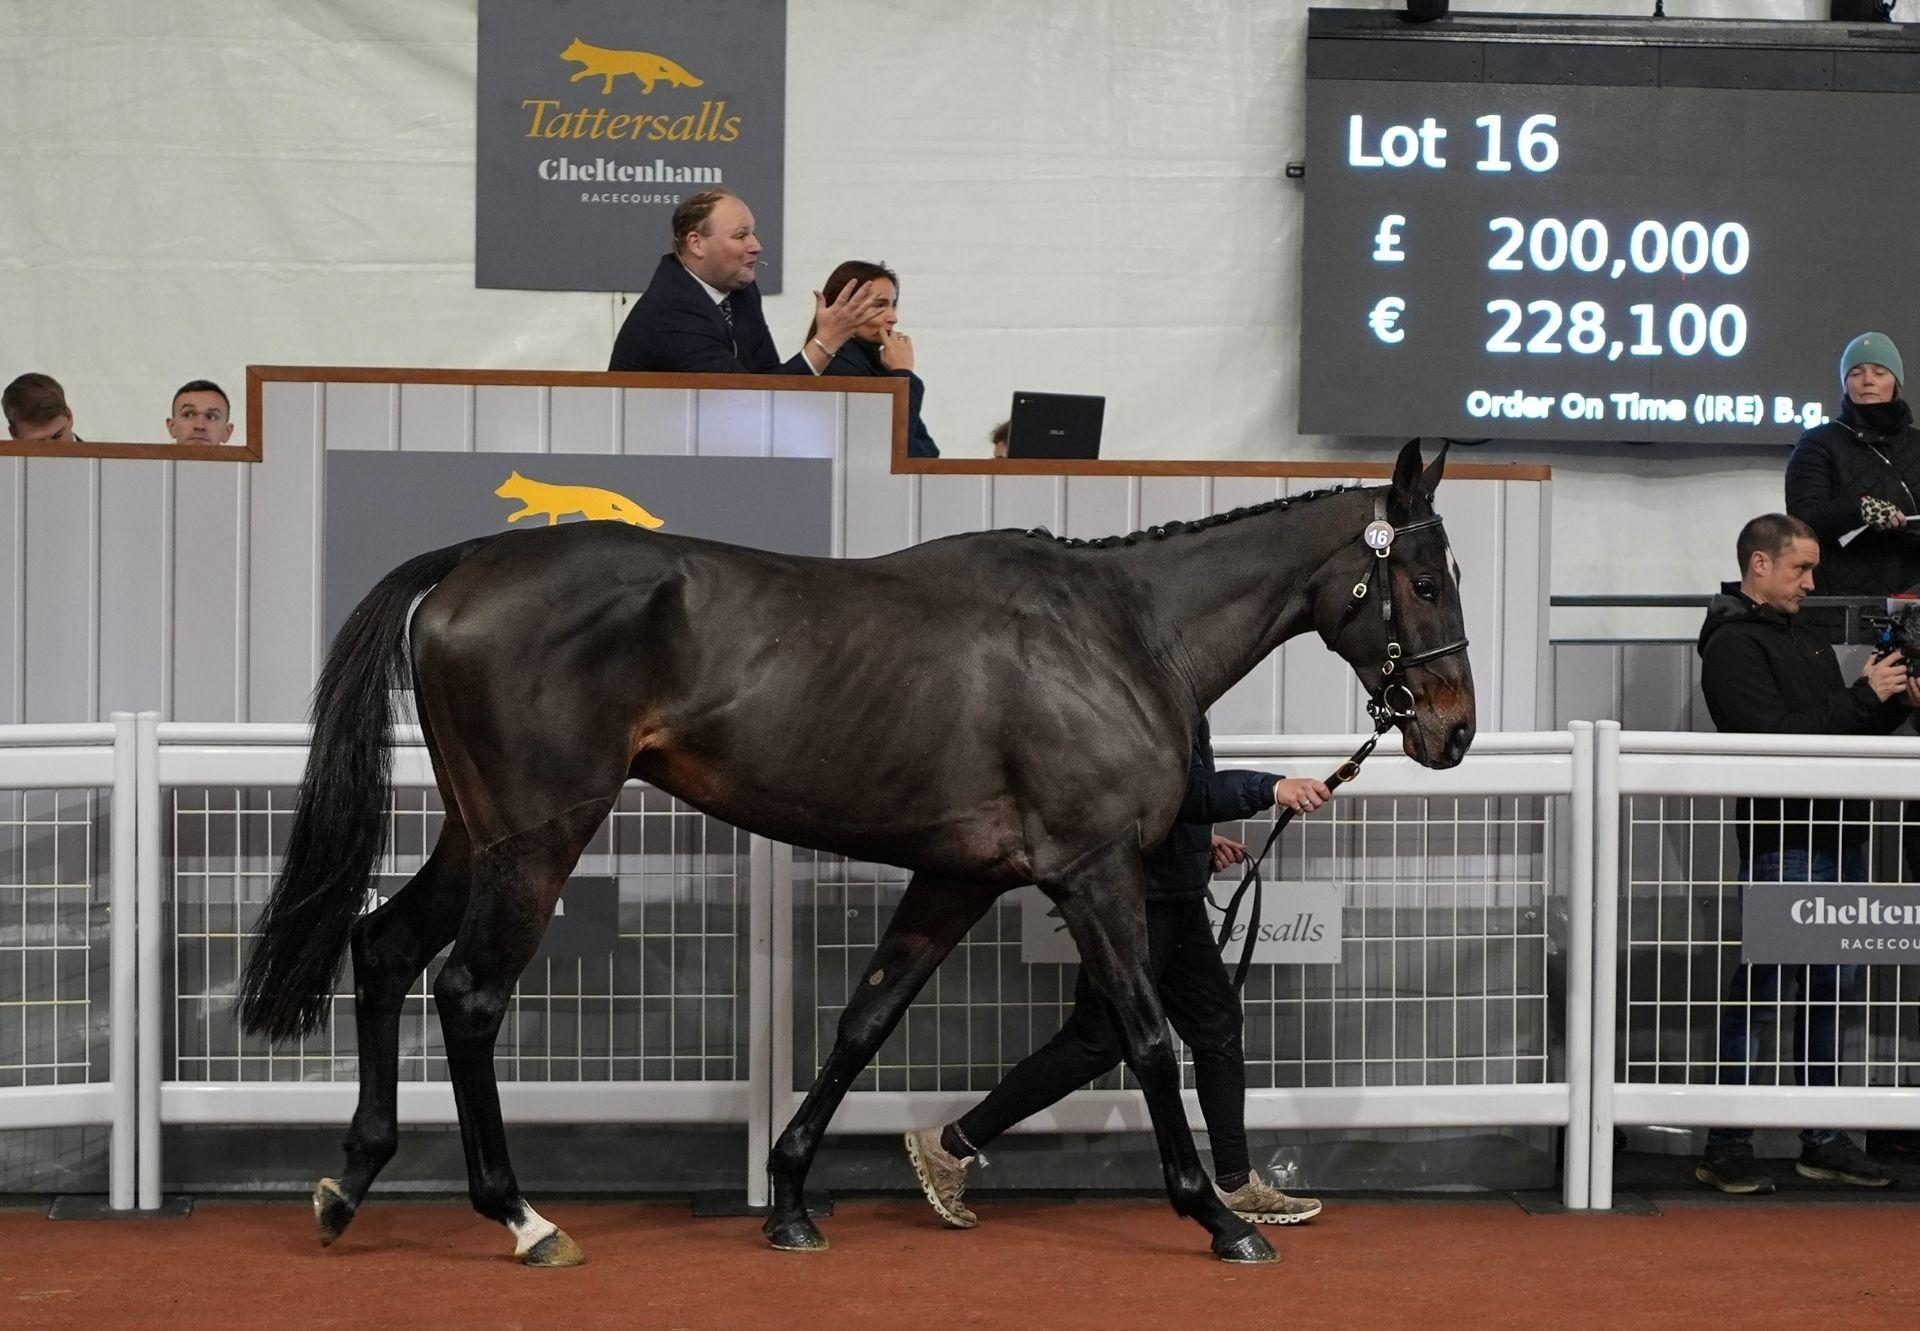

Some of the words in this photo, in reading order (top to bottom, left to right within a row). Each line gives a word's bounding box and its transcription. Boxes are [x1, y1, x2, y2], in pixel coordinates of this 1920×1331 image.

[521, 99, 742, 142] Tattersalls
[1348, 114, 1447, 169] Lot
[1475, 113, 1560, 172] 16
[538, 158, 723, 184] Cheltenham
[581, 192, 681, 205] RACECOURSE
[1373, 214, 1406, 262] £
[1487, 217, 1750, 279] 200,000
[1369, 296, 1405, 344] €
[1485, 299, 1748, 361] 228,100
[1466, 390, 1555, 419] Order
[1560, 392, 1604, 420] On
[1609, 391, 1687, 422] Time
[1693, 393, 1765, 426] (IRE)
[1773, 396, 1830, 430] B.g.
[1369, 529, 1388, 545] 16
